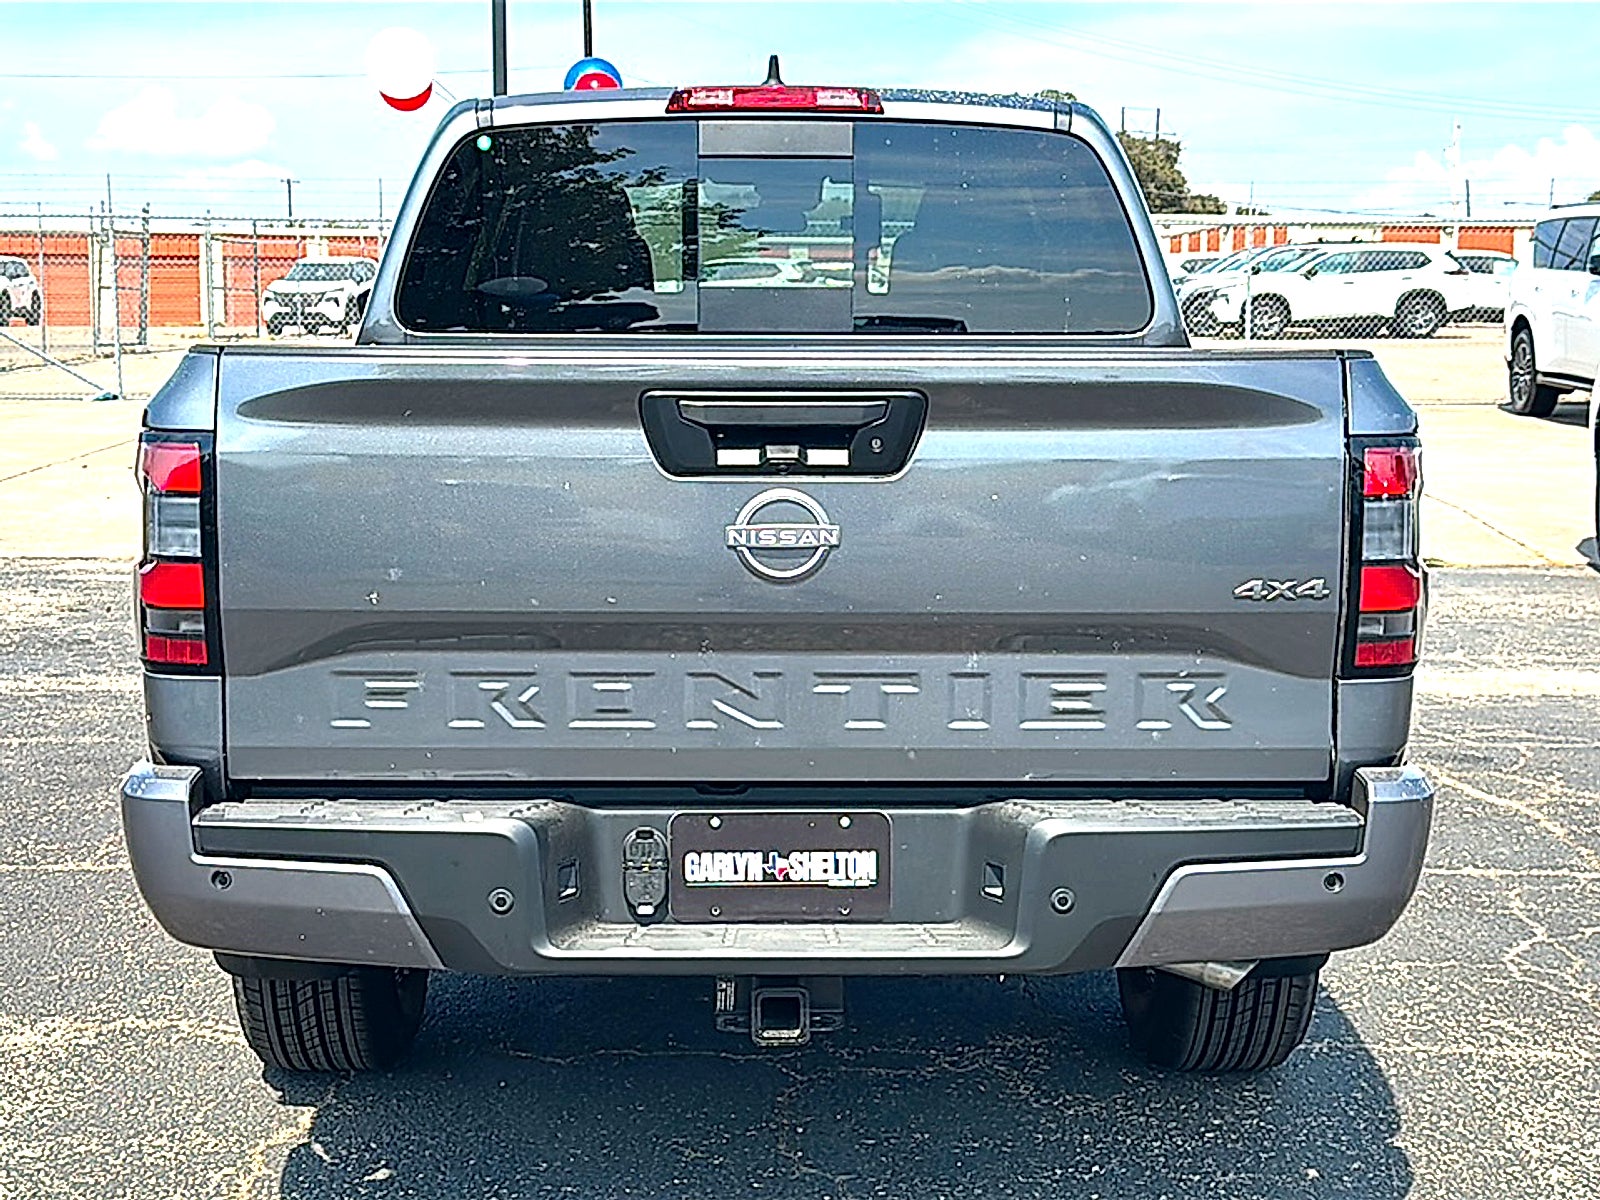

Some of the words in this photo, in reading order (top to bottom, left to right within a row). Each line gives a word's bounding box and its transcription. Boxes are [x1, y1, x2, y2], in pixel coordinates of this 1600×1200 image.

[727, 528, 839, 545] NISSAN
[329, 669, 1233, 730] FRONTIER
[684, 851, 764, 881] GARLYN
[788, 850, 877, 881] SHELTON
